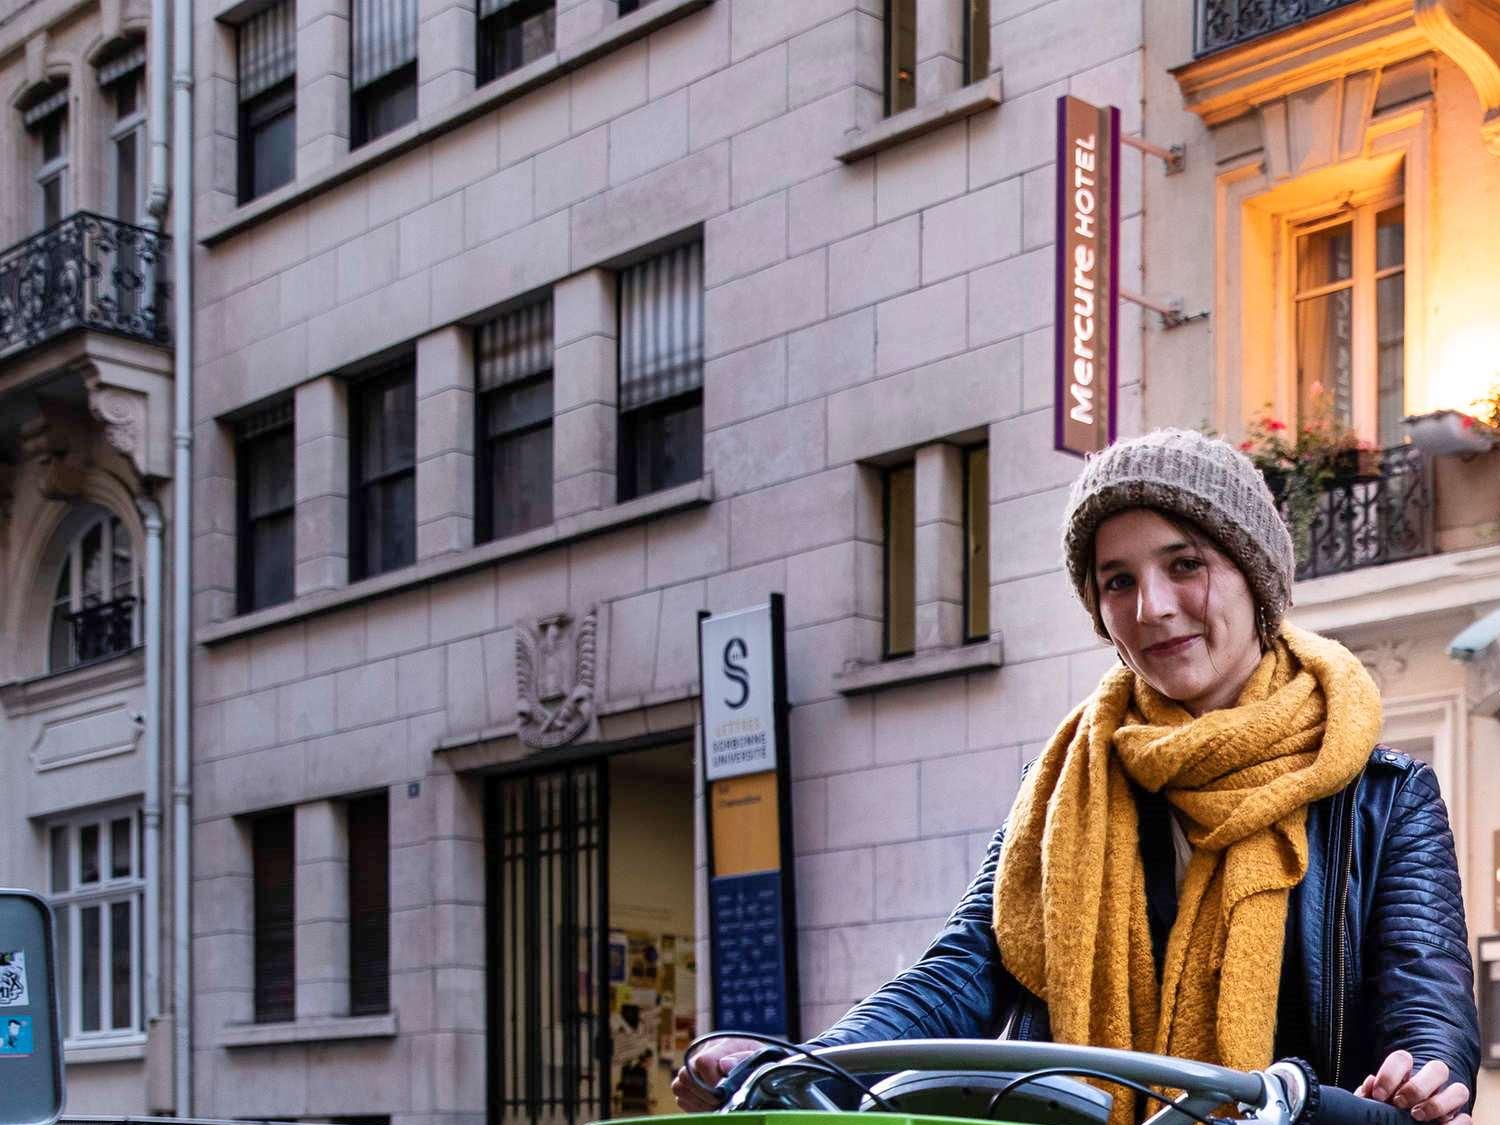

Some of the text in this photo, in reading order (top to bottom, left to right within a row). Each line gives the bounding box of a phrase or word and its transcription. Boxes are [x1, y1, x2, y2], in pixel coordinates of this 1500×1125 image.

[1070, 134, 1096, 424] Mercure HOTEL
[712, 734, 767, 752] SORBONNE
